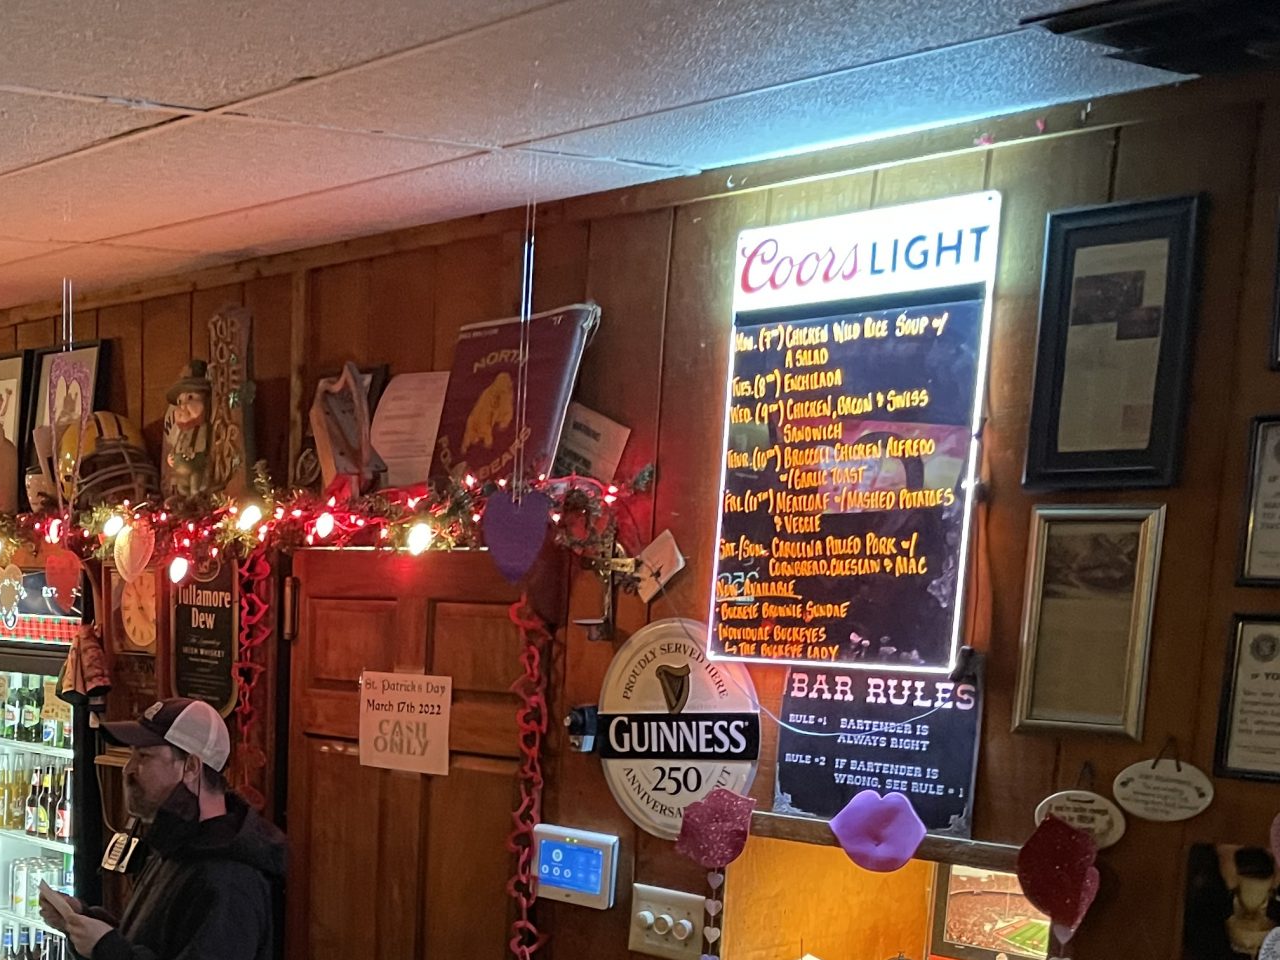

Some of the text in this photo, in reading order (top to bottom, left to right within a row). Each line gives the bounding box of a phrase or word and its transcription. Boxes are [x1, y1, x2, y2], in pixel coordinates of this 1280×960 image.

[740, 225, 990, 294] Coors LIGHT
[785, 324, 829, 348] CHICKEN
[833, 320, 861, 342] WILD
[863, 317, 888, 339] RICE
[895, 313, 928, 337] SOUP
[784, 348, 829, 369] A SALAD
[783, 370, 842, 394] ENCHILADA
[837, 392, 872, 416] BACON
[886, 389, 929, 412] SWISS
[783, 421, 843, 444] SANDWICH
[784, 444, 830, 468] BROCCOLI
[833, 440, 882, 463] CHICKEN
[886, 436, 936, 458] ALFREDO
[830, 465, 867, 485] TOAST
[776, 493, 830, 514] MEATLOAF
[899, 487, 956, 509] POTATOES
[783, 512, 822, 534] VEGGIE
[771, 537, 823, 558] CAROLINA
[825, 535, 862, 556] PULLED
[865, 533, 898, 555] PORK
[894, 555, 929, 576] MAC
[178, 584, 232, 608] Tullamore
[742, 578, 796, 597] AVAILABLE
[191, 607, 216, 630] Dew
[721, 600, 851, 622] BUCKEYE BROWNIE SUNDAE
[717, 624, 827, 643] INDIVIDUAL BUCKEYES
[738, 641, 840, 662] THE BUCKEYE LADY
[622, 642, 729, 700] PROUDLY SERVED HERE
[426, 682, 447, 697] Day
[790, 673, 976, 710] BAR RULES
[366, 698, 442, 716] March 17th 2022
[378, 719, 428, 739] CASH
[788, 713, 816, 725] RULE
[839, 717, 930, 736] BARTENDER IS
[608, 715, 747, 754] GUINNESS
[836, 733, 930, 752] ALWAYS RIGHT
[373, 735, 429, 757] ONLY
[784, 753, 812, 765] RULE
[834, 758, 940, 780] IF BARTENDER IS
[651, 765, 703, 796] 250
[884, 779, 908, 791] SEE
[911, 782, 945, 796] RULE
[623, 766, 684, 819] ANNIVERSA
